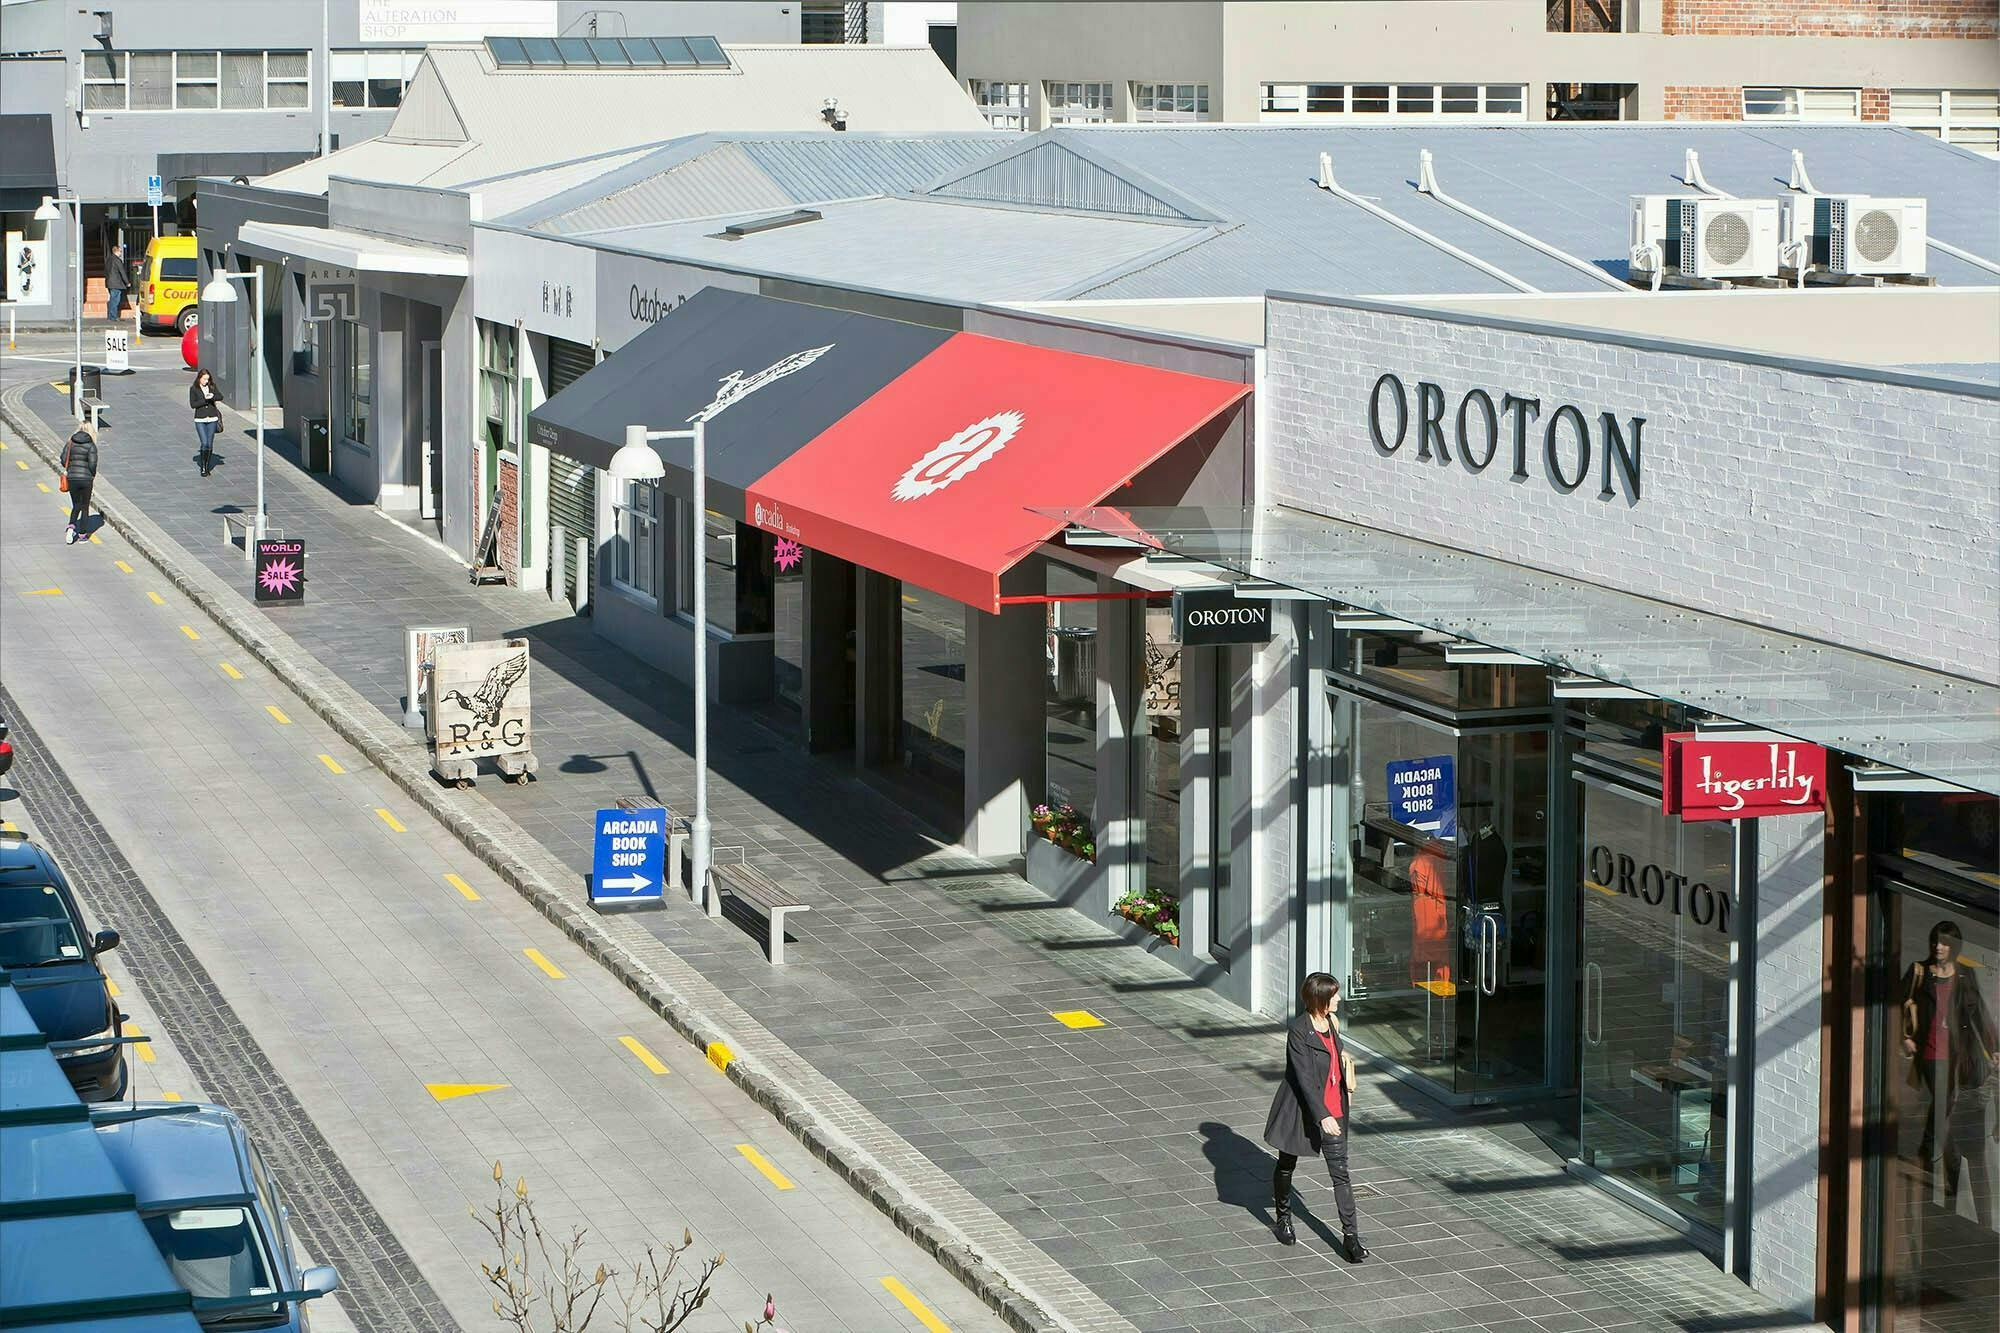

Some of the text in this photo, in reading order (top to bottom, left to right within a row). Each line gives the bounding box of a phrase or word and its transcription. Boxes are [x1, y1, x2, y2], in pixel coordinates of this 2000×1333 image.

[367, 10, 457, 22] ALTERATION
[365, 25, 407, 37] SHOP
[310, 270, 355, 279] AREA
[106, 337, 127, 352] SALE
[1368, 373, 1647, 509] OROTON
[260, 544, 302, 552] WORLD
[267, 571, 290, 580] SALE
[1188, 607, 1266, 627] OROTON
[1696, 743, 1815, 811] tigerlily
[602, 820, 659, 835] ARCADIA
[612, 836, 648, 851] BOOK
[611, 852, 648, 867] SHOP
